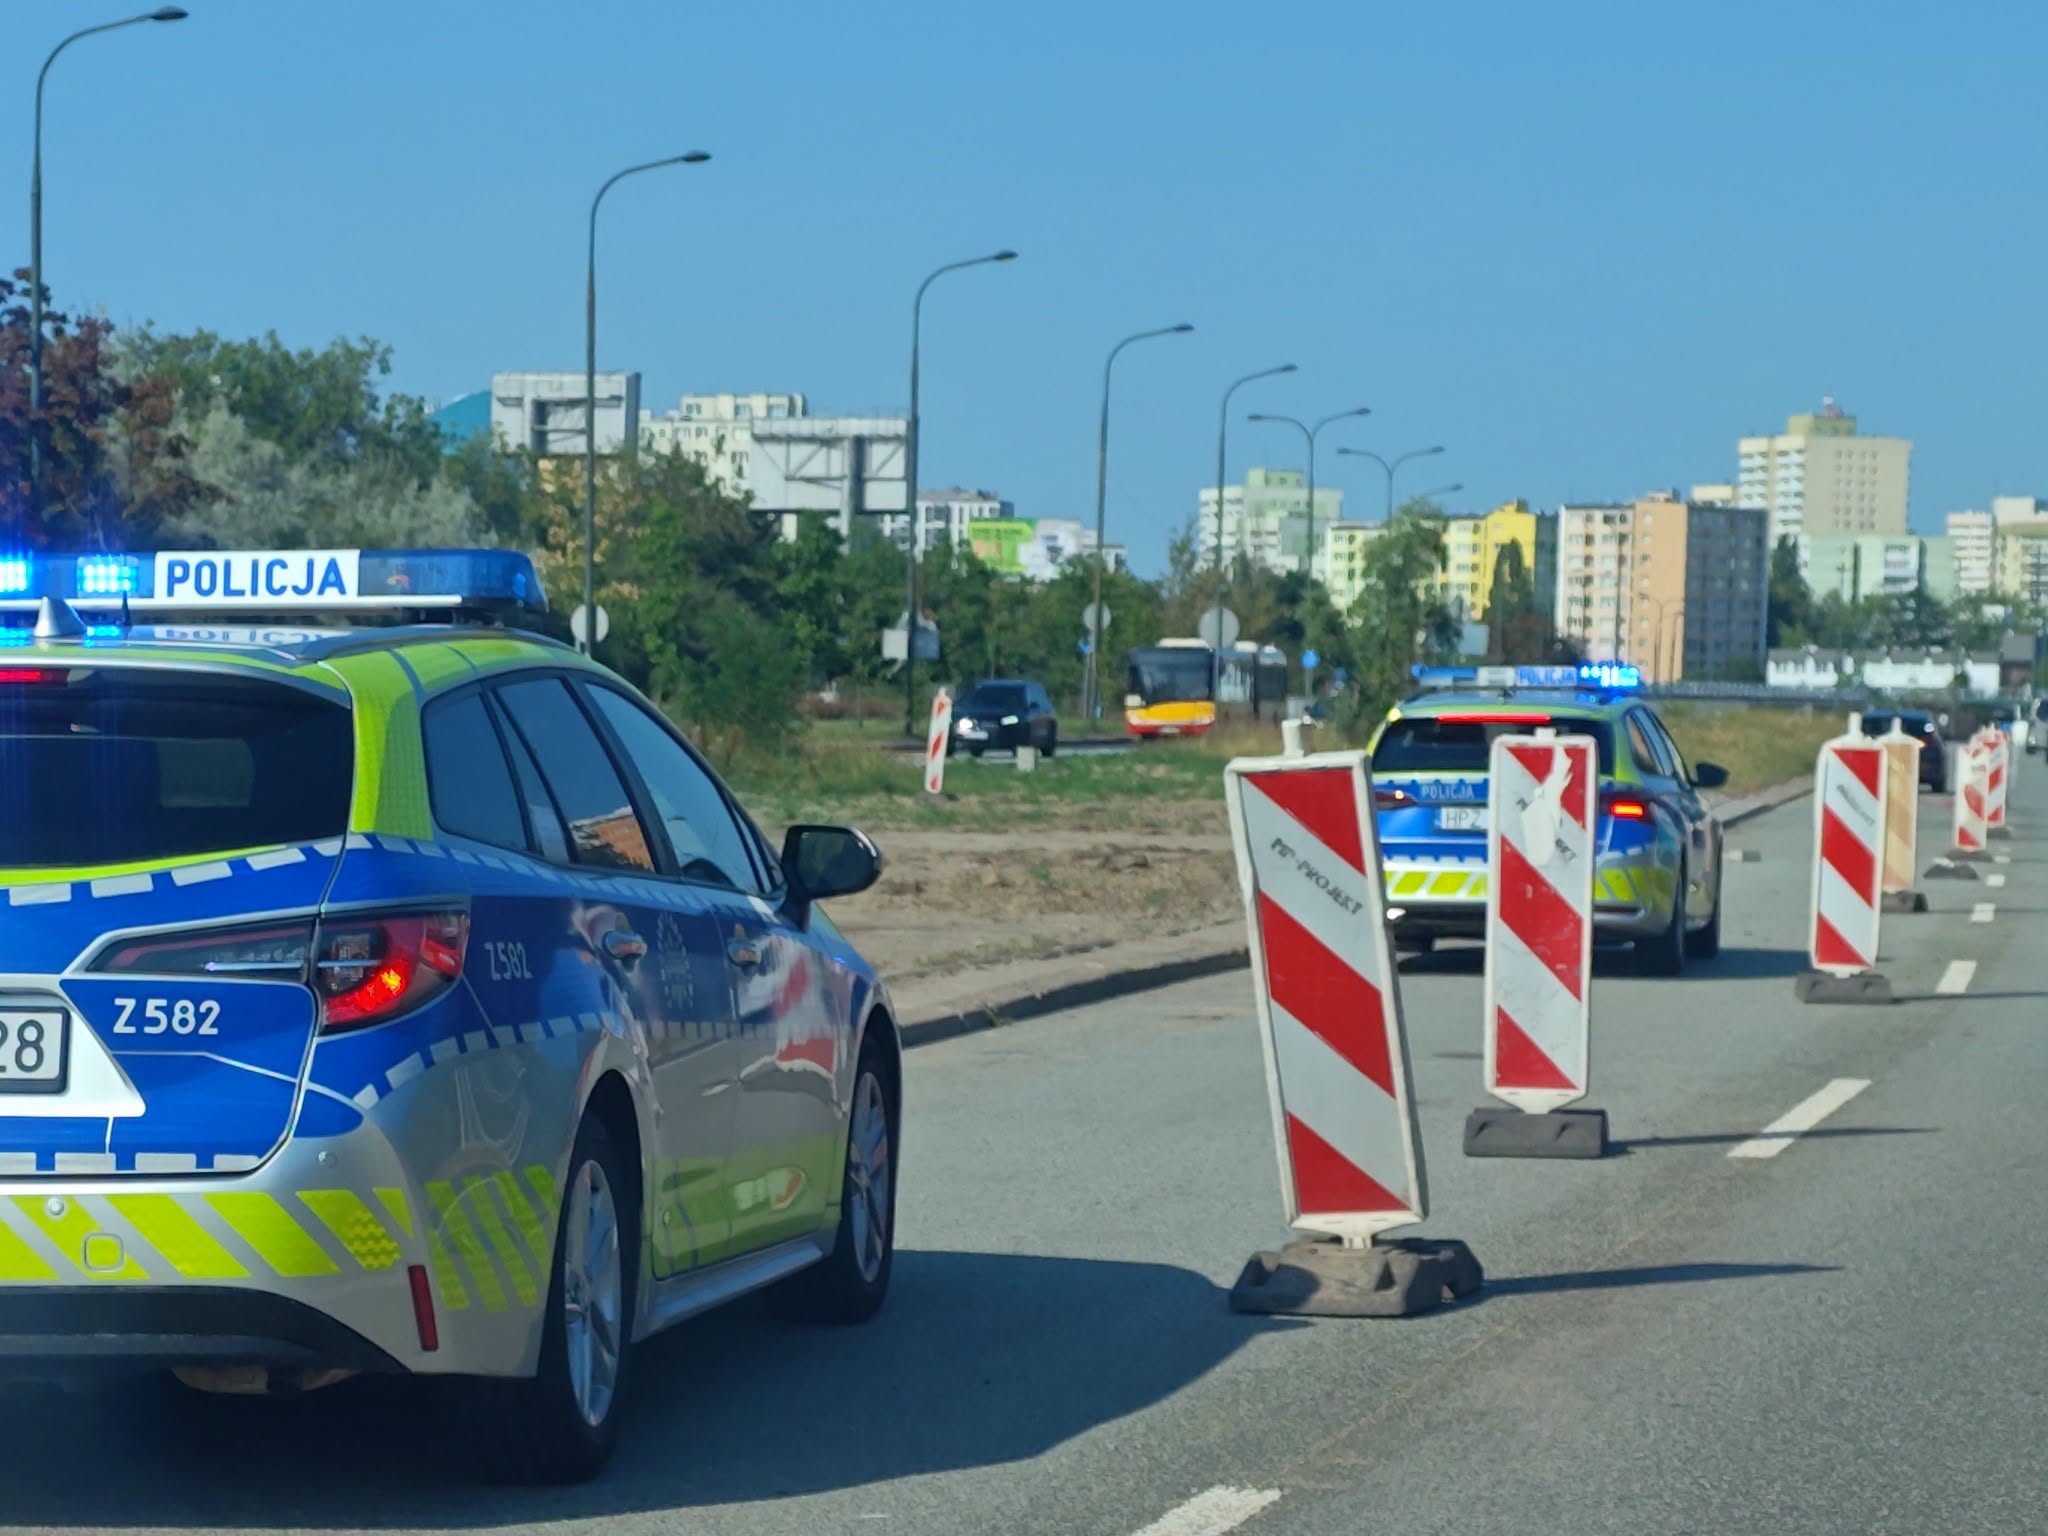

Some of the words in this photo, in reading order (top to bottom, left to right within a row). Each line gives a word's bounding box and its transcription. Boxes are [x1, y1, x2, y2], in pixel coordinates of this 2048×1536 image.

[167, 557, 347, 598] POLICJA
[1519, 667, 1576, 685] POLICJA
[1421, 784, 1475, 799] POLICJA
[484, 942, 533, 980] Z582
[113, 998, 220, 1035] Z582
